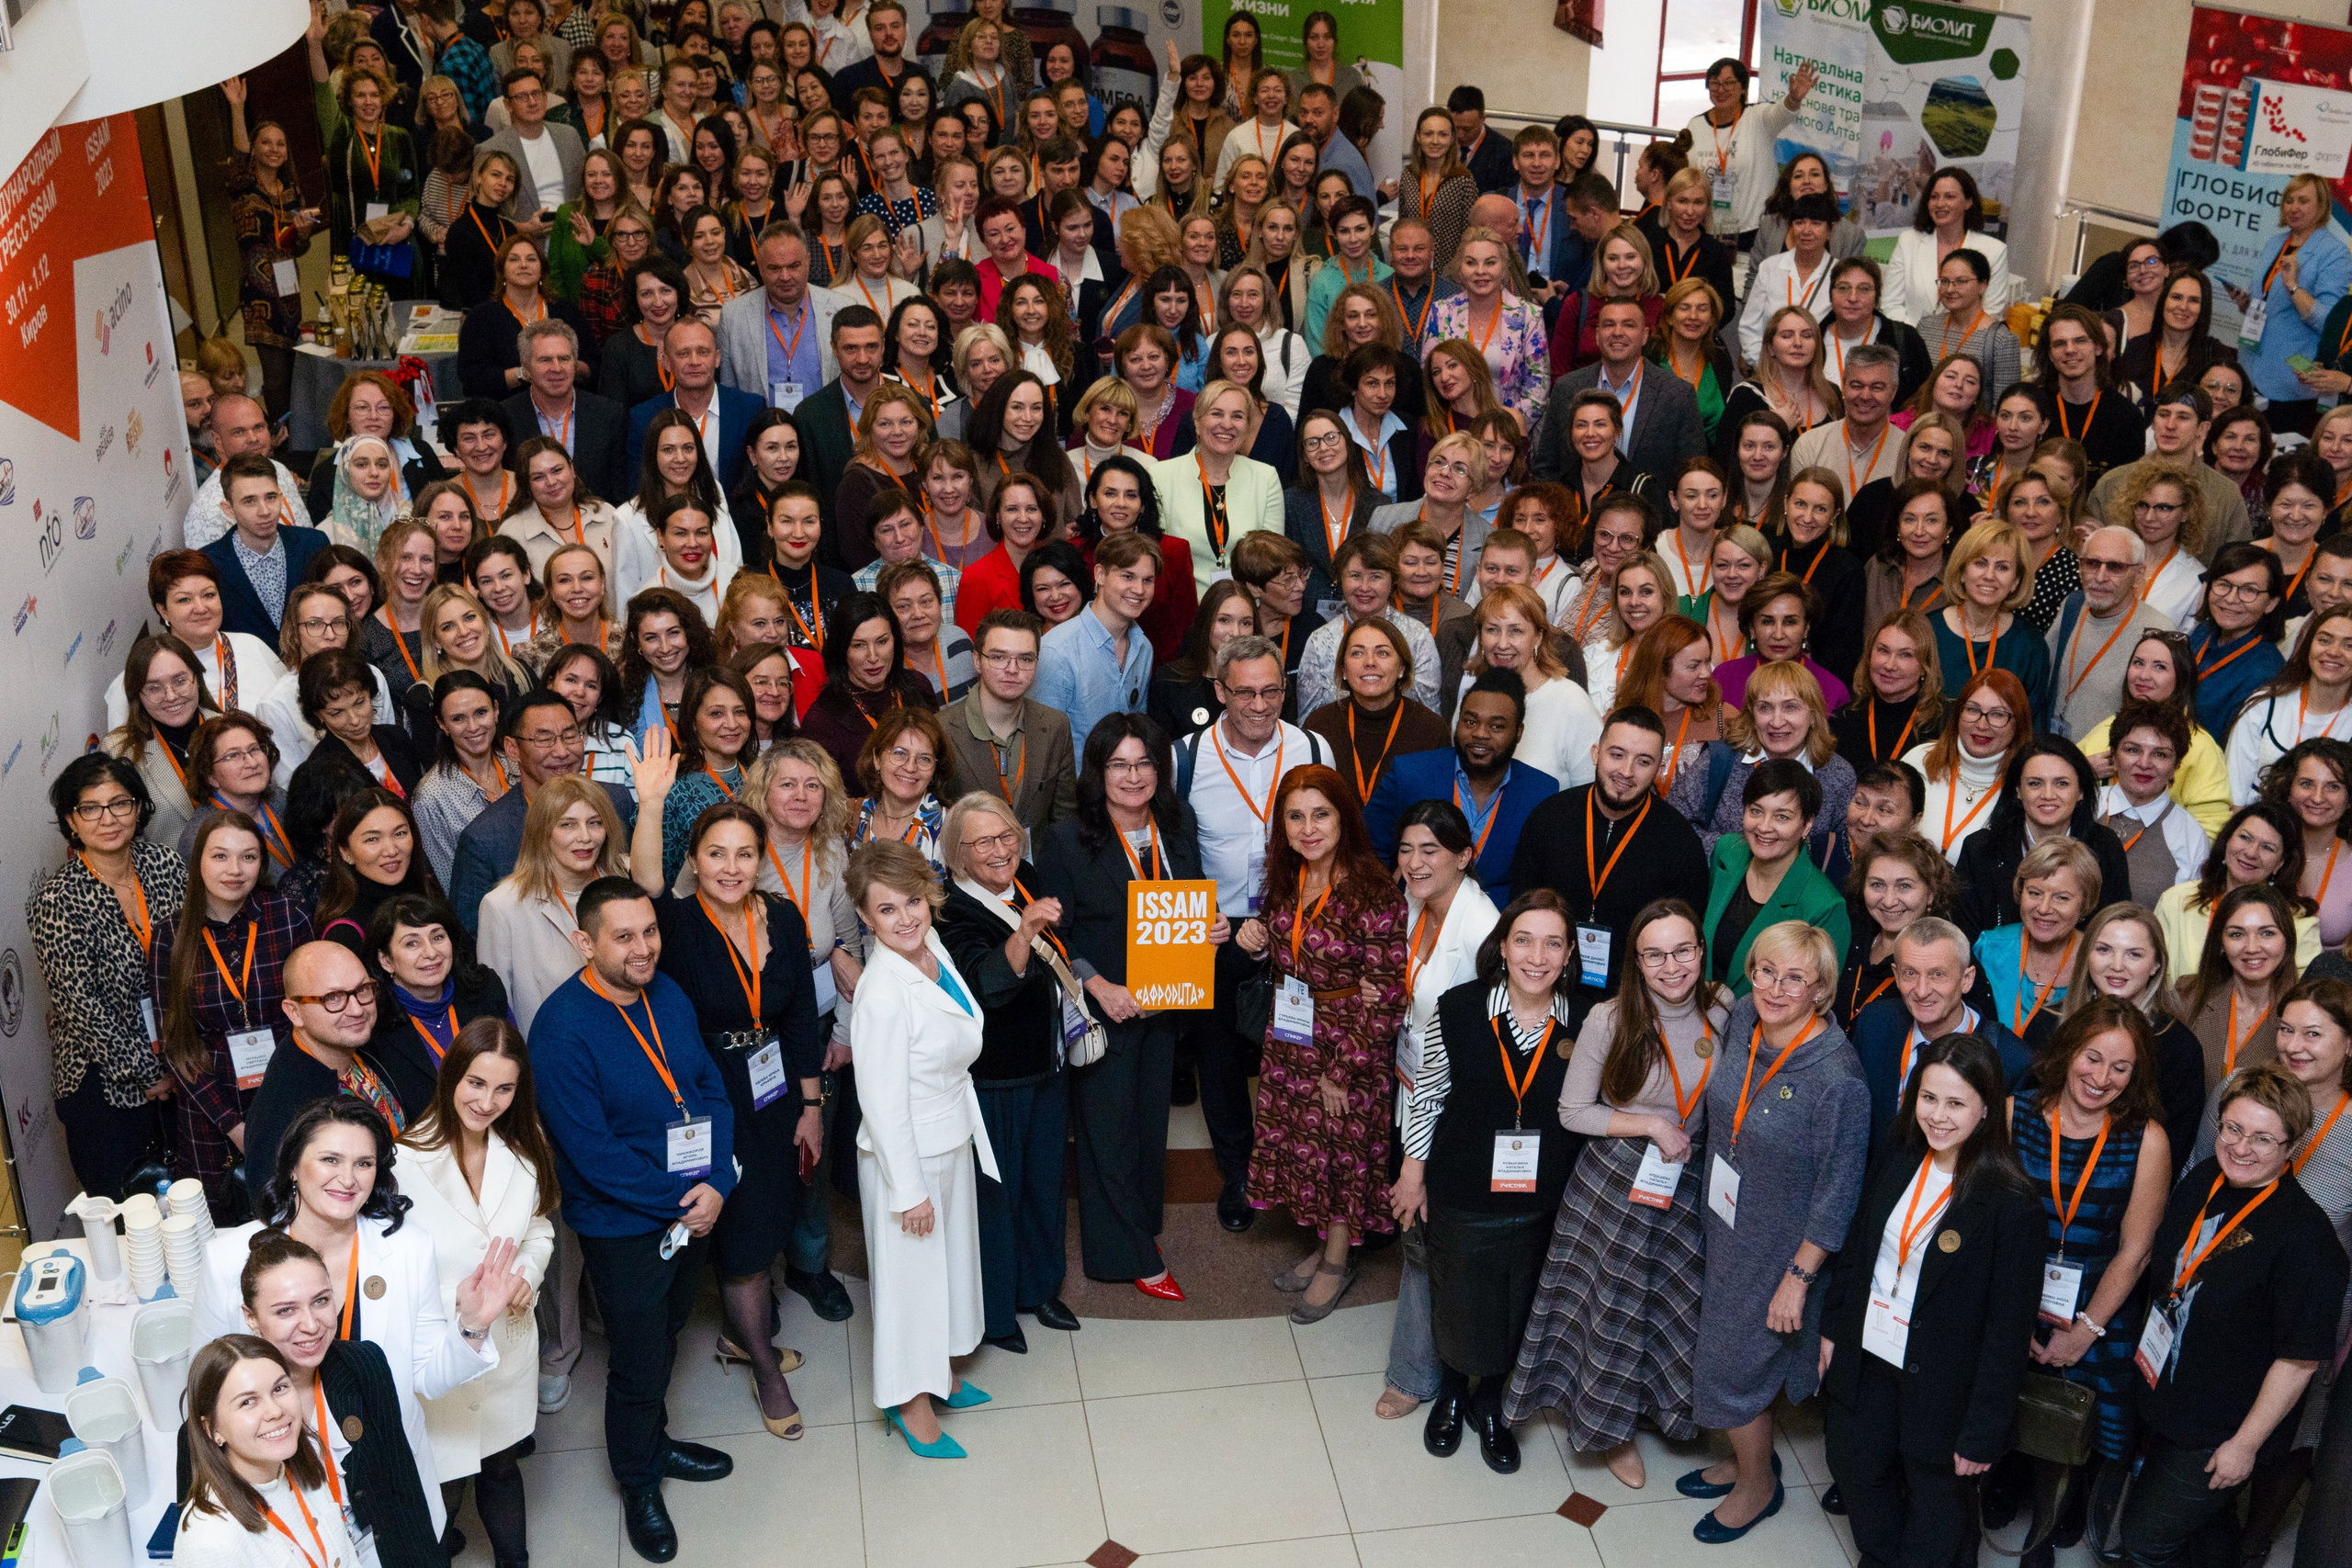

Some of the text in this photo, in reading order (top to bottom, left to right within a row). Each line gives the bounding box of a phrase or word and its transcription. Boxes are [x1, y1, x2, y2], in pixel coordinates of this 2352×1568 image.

[1230, 0, 1290, 17] ЖИЗНИ
[1911, 14, 1976, 39] БИОЛИТ
[1780, 70, 1861, 103] кетика
[85, 117, 110, 166] ISSAM
[2254, 145, 2308, 161] ГлобиФер
[95, 157, 113, 197] 2023
[2180, 171, 2282, 208] ГЛОБИФ
[27, 179, 57, 234] ISSAM
[2176, 198, 2261, 231] ФОРТЕ
[6, 280, 28, 325] 30.11
[32, 254, 50, 290] 1.12
[109, 281, 132, 330] acino
[20, 304, 48, 349] Киров
[1136, 891, 1207, 919] ISSAM
[1136, 920, 1206, 945] 2023
